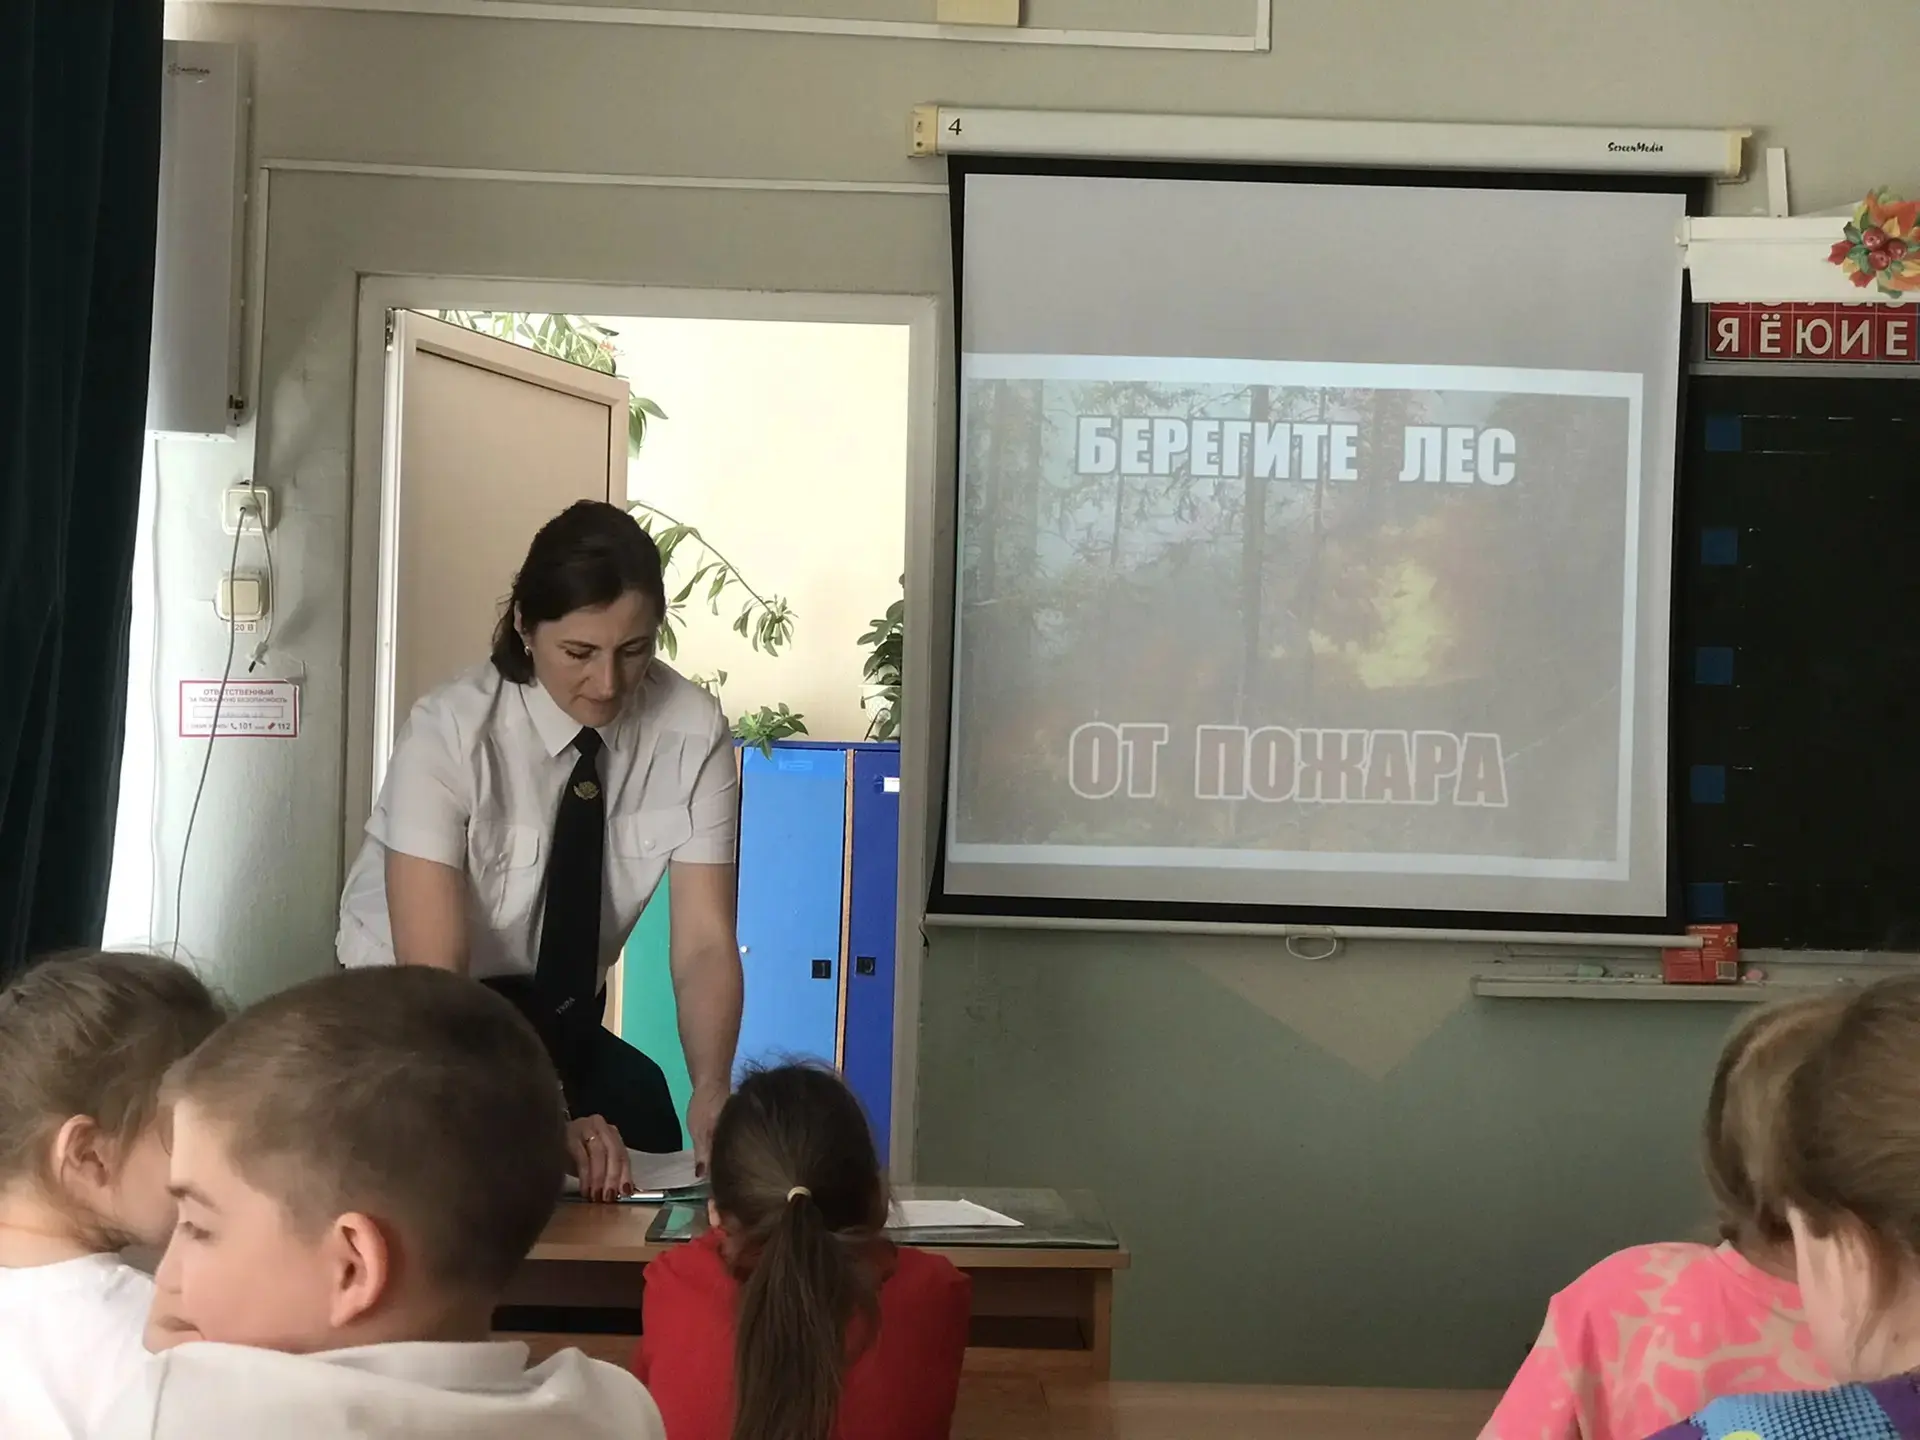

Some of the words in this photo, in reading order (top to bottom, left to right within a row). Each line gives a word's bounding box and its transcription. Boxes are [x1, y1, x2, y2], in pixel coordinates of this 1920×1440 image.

[947, 118, 962, 135] 4
[1607, 142, 1664, 153] ScreenMedia
[1077, 415, 1359, 481] БЕРЕГИТЕ
[1399, 424, 1517, 486] ЛЕС
[203, 688, 274, 696] ОТВТСТВЕННЫЙ
[1069, 722, 1169, 799] ОТ
[1195, 725, 1508, 807] ПОЖАРА
